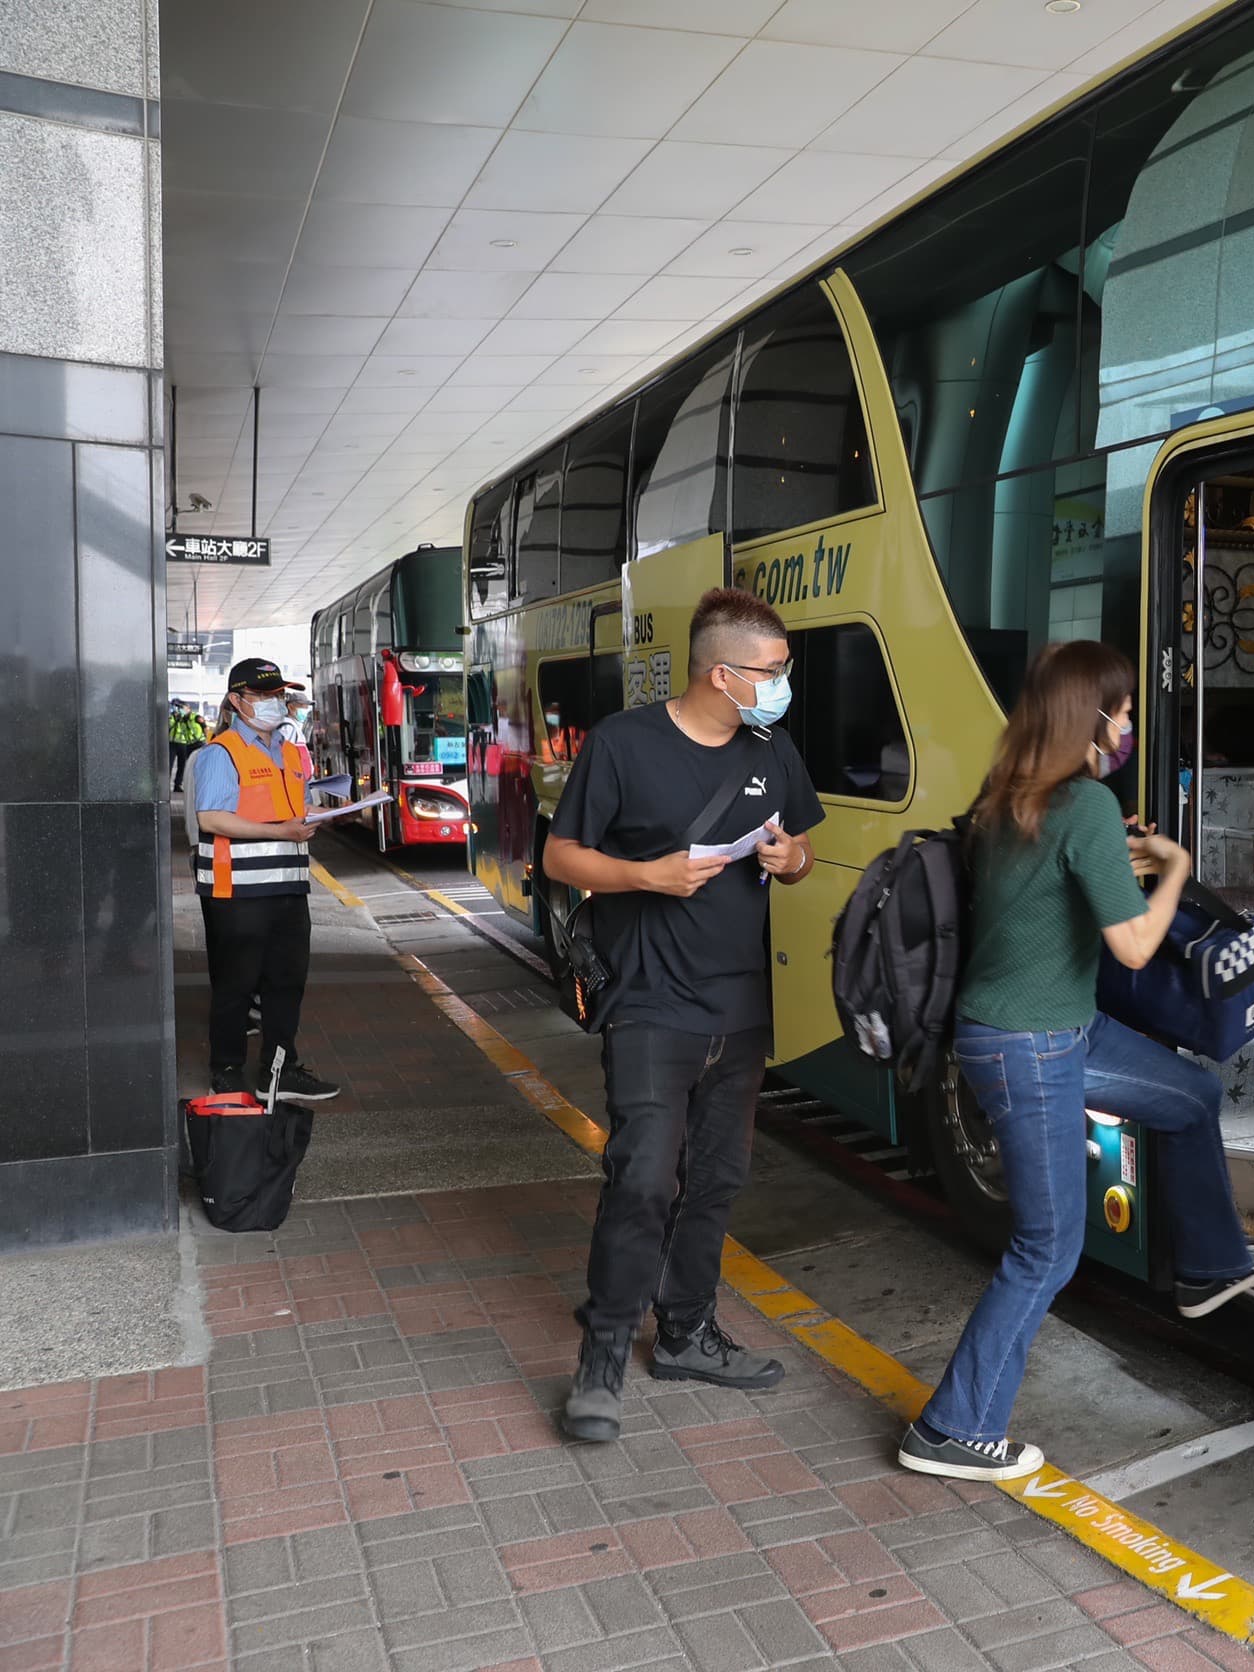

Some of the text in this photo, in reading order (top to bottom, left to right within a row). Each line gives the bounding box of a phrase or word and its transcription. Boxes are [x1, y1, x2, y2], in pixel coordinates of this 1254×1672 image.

[185, 538, 267, 558] 車站大廳2F
[634, 613, 653, 645] BUS
[1061, 1494, 1187, 1574] No Smoking
